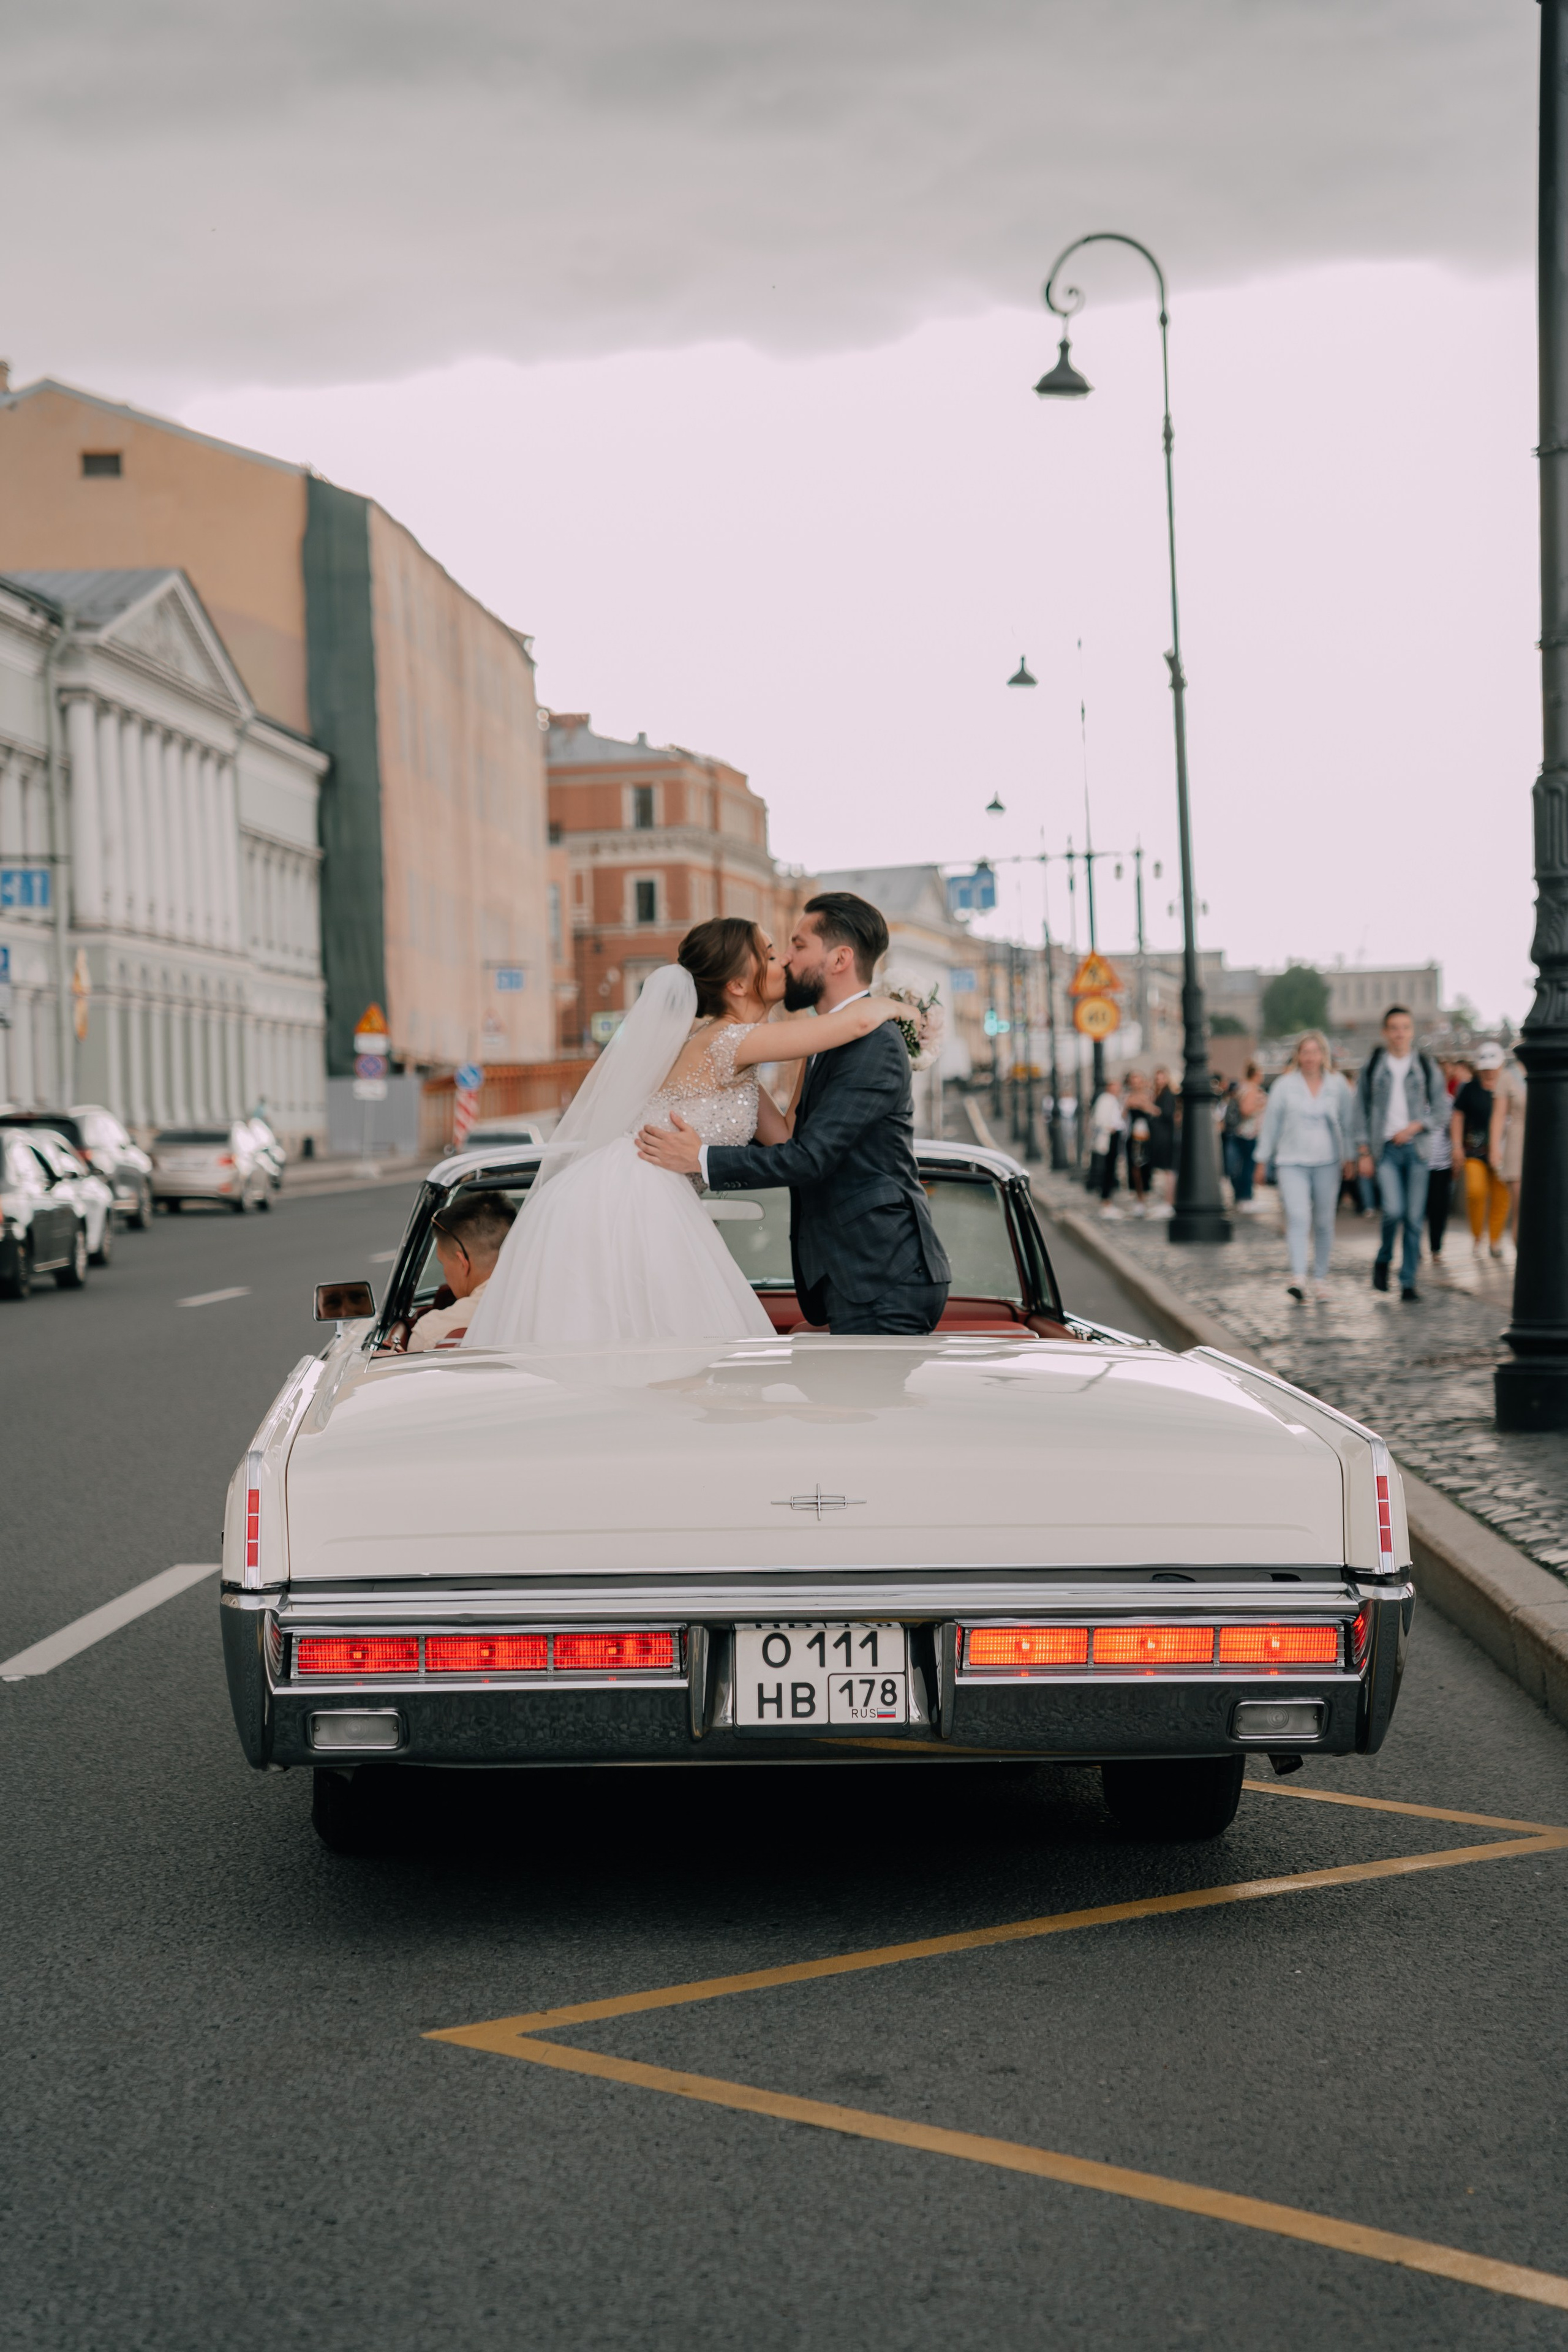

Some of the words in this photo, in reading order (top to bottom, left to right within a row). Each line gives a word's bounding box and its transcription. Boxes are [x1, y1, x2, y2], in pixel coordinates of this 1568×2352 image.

[806, 1630, 878, 1667] 111
[839, 1679, 897, 1707] 178
[851, 1708, 876, 1719] RUS
